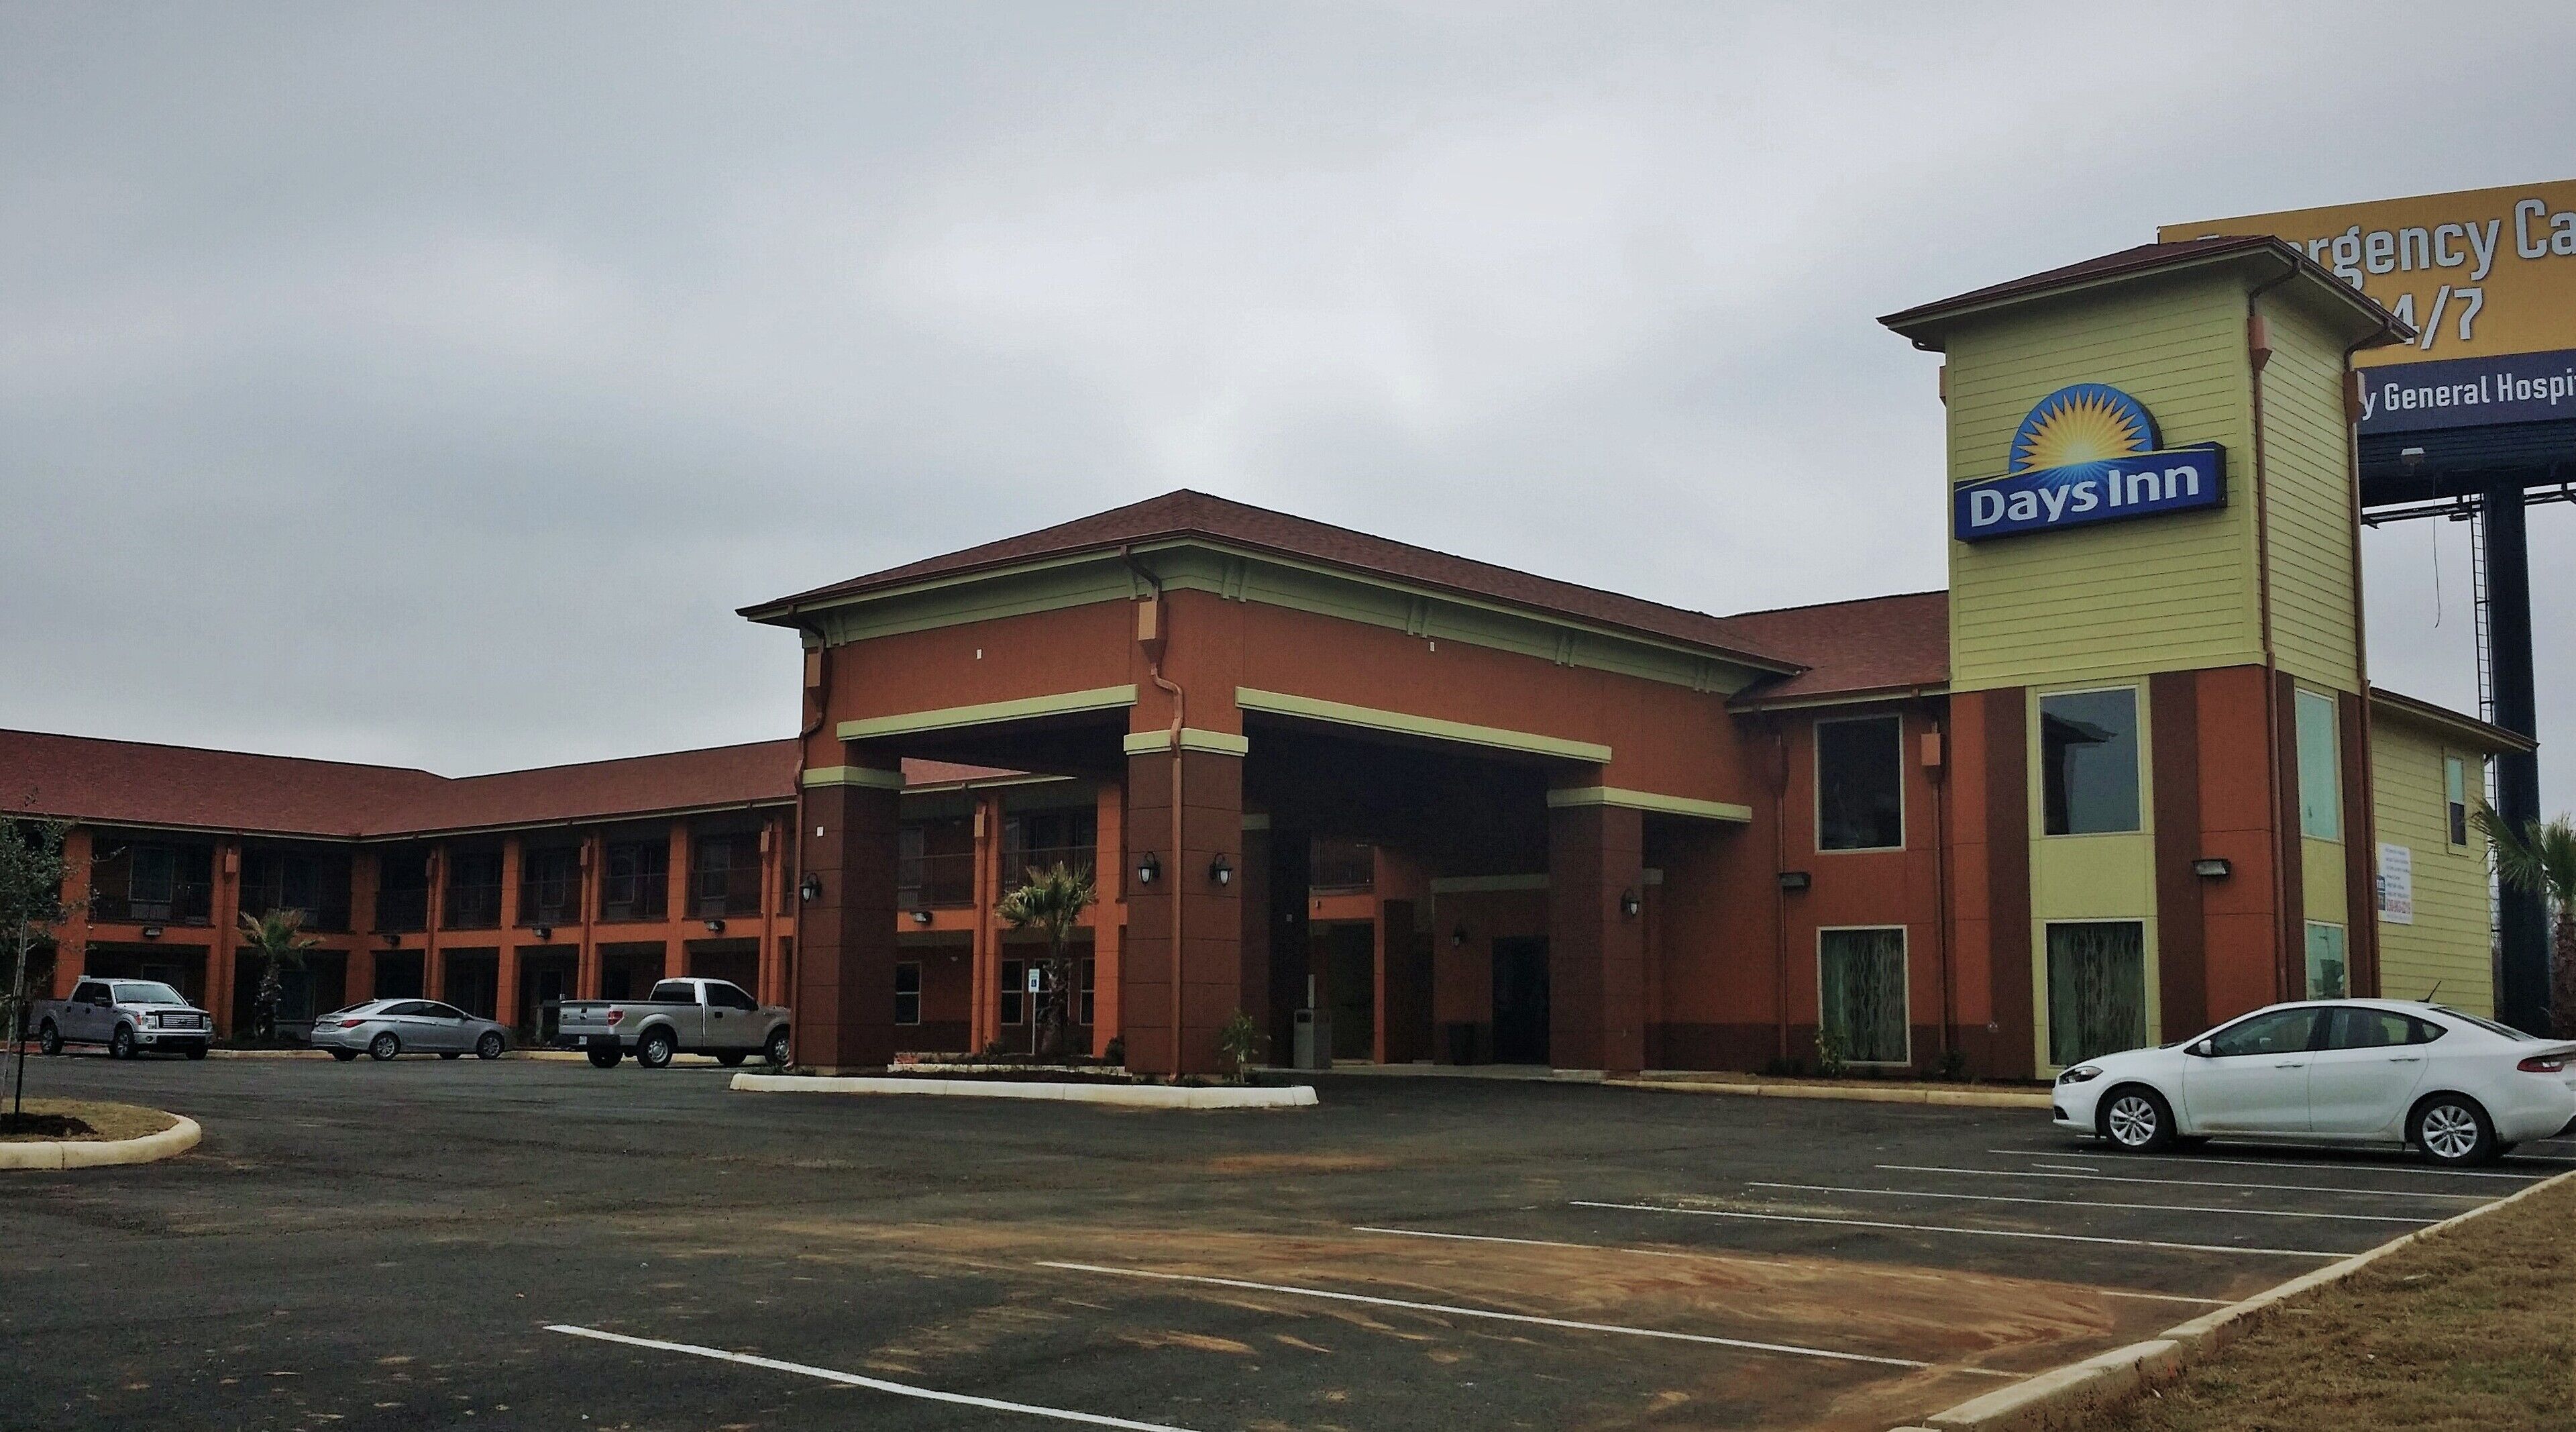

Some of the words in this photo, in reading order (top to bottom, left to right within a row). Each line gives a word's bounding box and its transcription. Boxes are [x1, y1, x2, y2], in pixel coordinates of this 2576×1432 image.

[2196, 219, 2500, 291] rgency
[2371, 285, 2483, 350] 4/7
[2383, 375, 2490, 411] General
[2496, 368, 2576, 406] Hospi
[1970, 480, 2099, 527] Days
[2108, 465, 2199, 507] Inn
